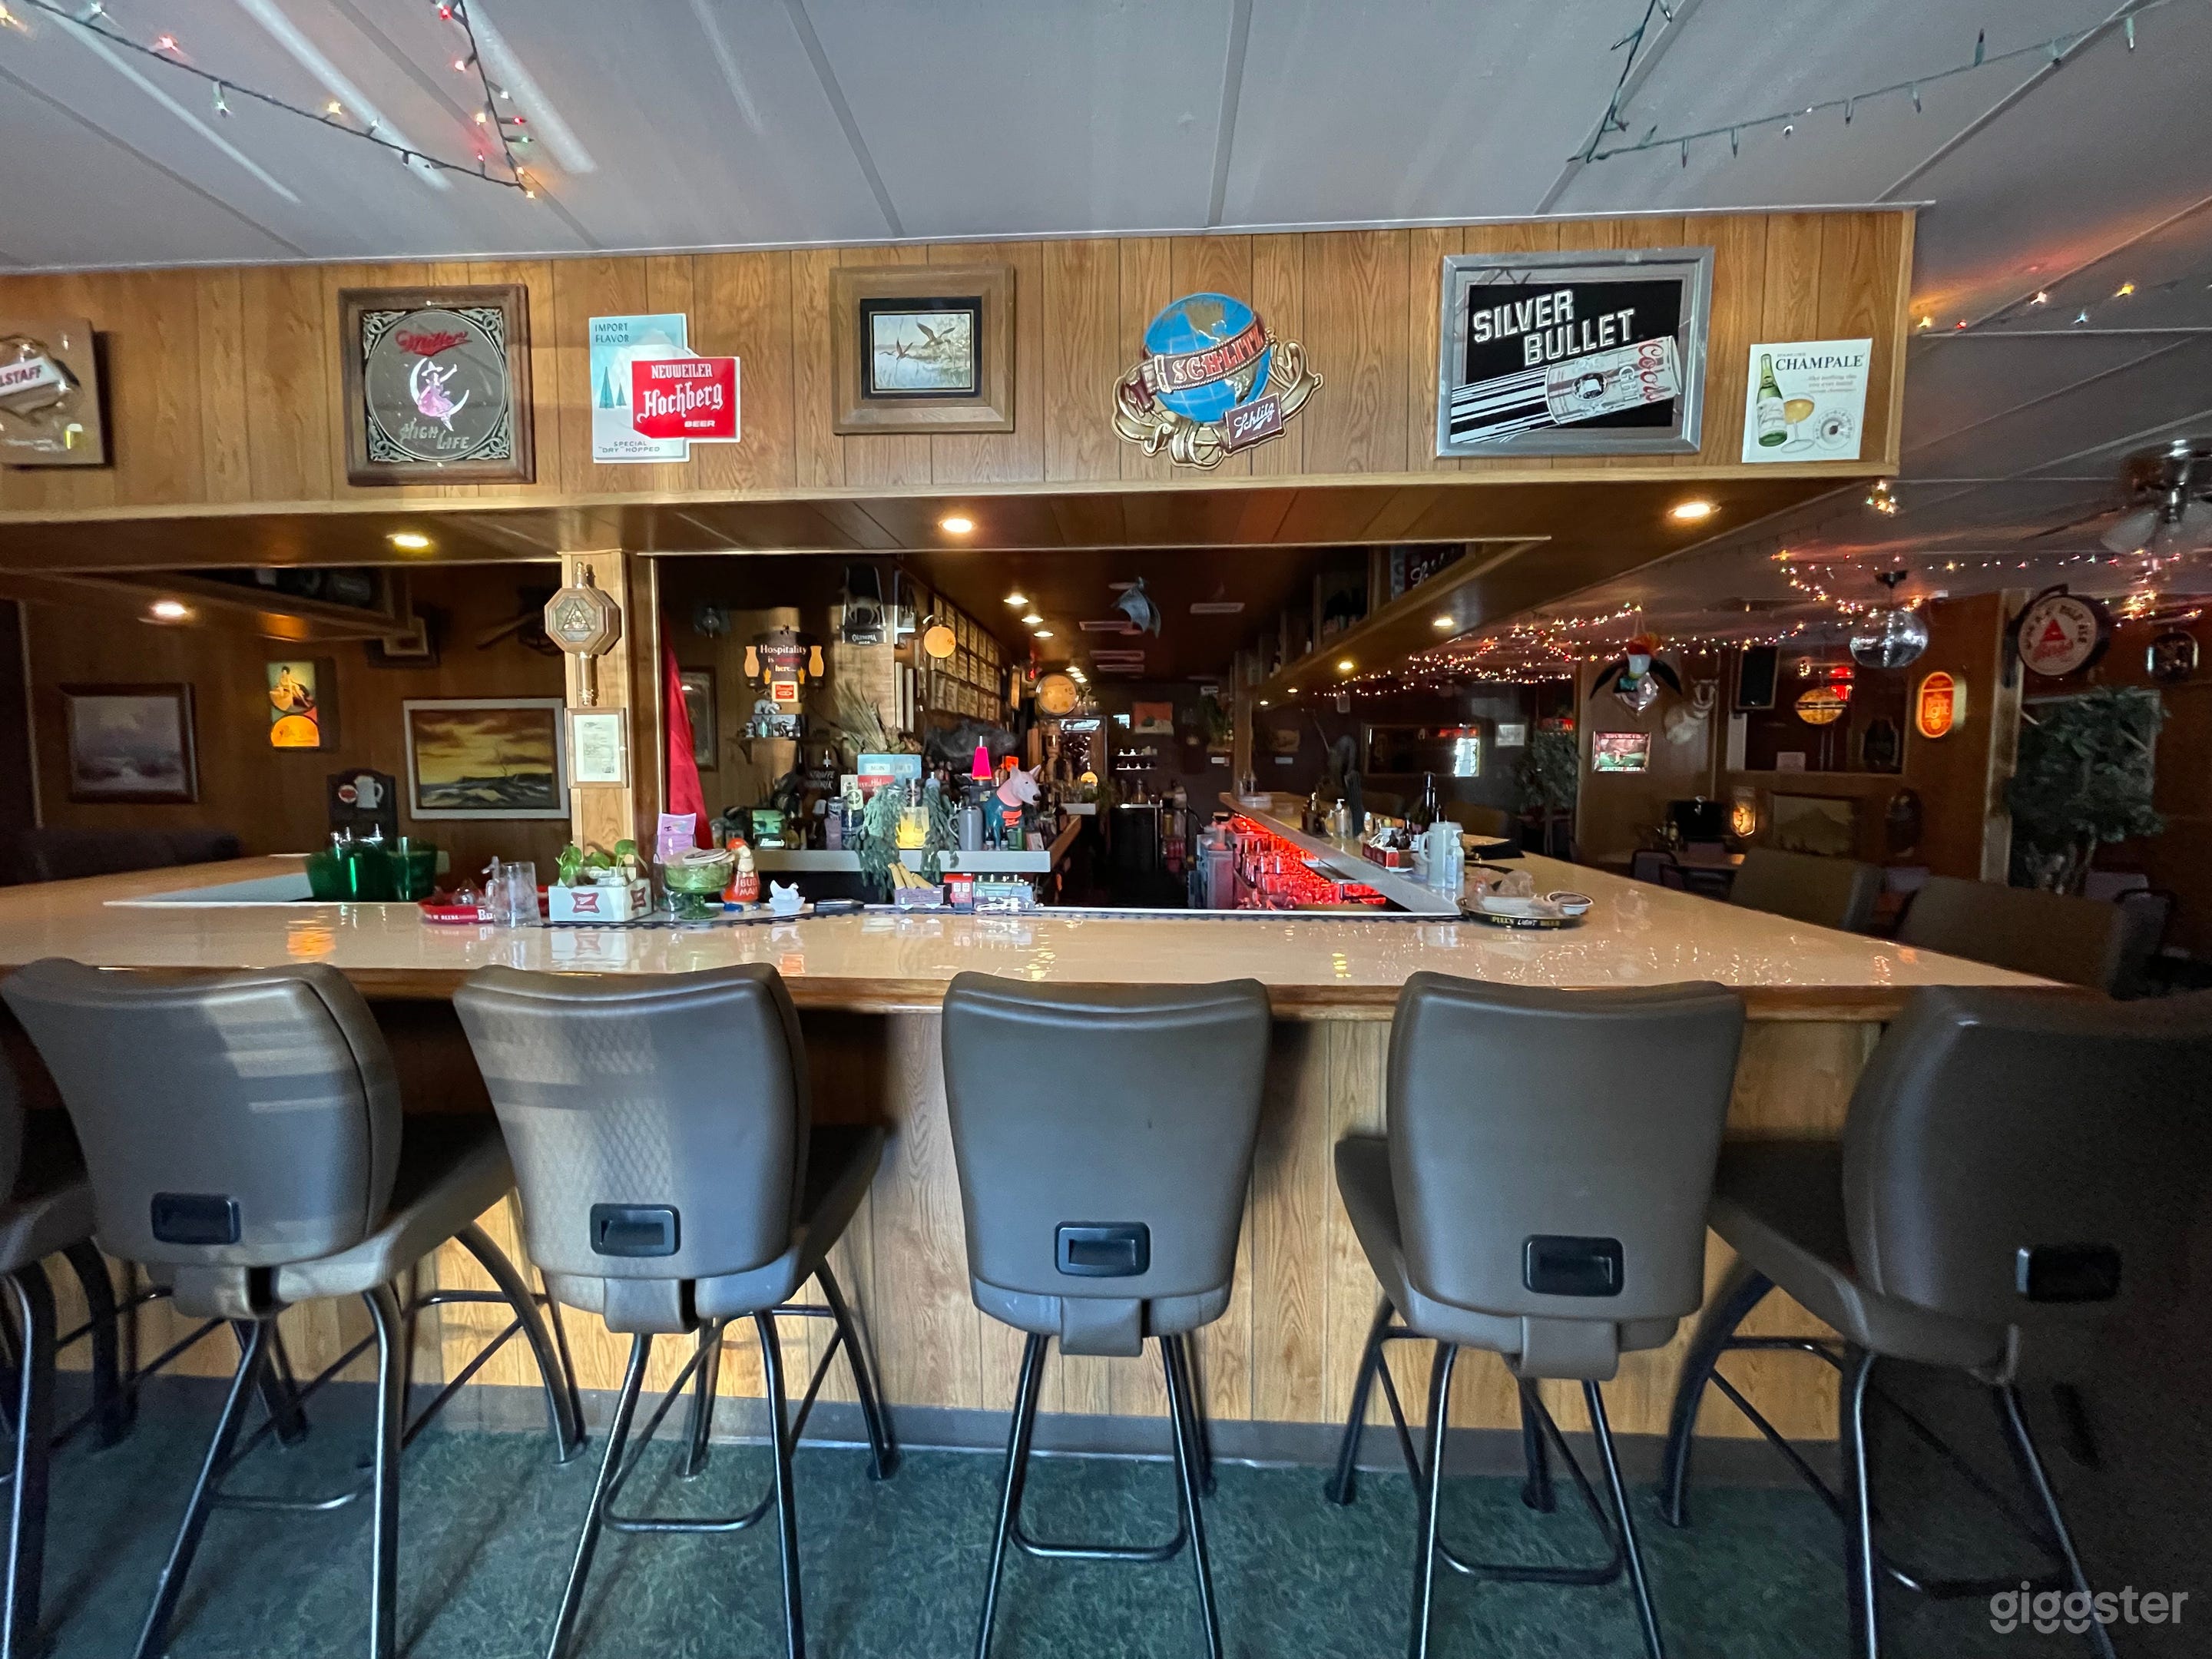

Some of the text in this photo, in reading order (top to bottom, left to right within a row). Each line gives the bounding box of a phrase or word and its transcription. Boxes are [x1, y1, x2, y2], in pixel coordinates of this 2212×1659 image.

[594, 323, 628, 332] IMPORT
[1473, 289, 1575, 343] SILVER
[395, 329, 471, 357] Miller
[595, 334, 629, 343] FLAVOR
[1524, 309, 1635, 366] BULLET
[1172, 325, 1264, 384] SCHLITZ
[1776, 355, 1863, 371] CHAMPALE
[651, 363, 713, 379] NEUWEILER
[637, 382, 724, 423] Hochberg
[399, 418, 470, 449] HIGH LIFE
[1233, 402, 1275, 438] Schlitz
[760, 644, 806, 655] Hospitality
[740, 878, 758, 887] BUD
